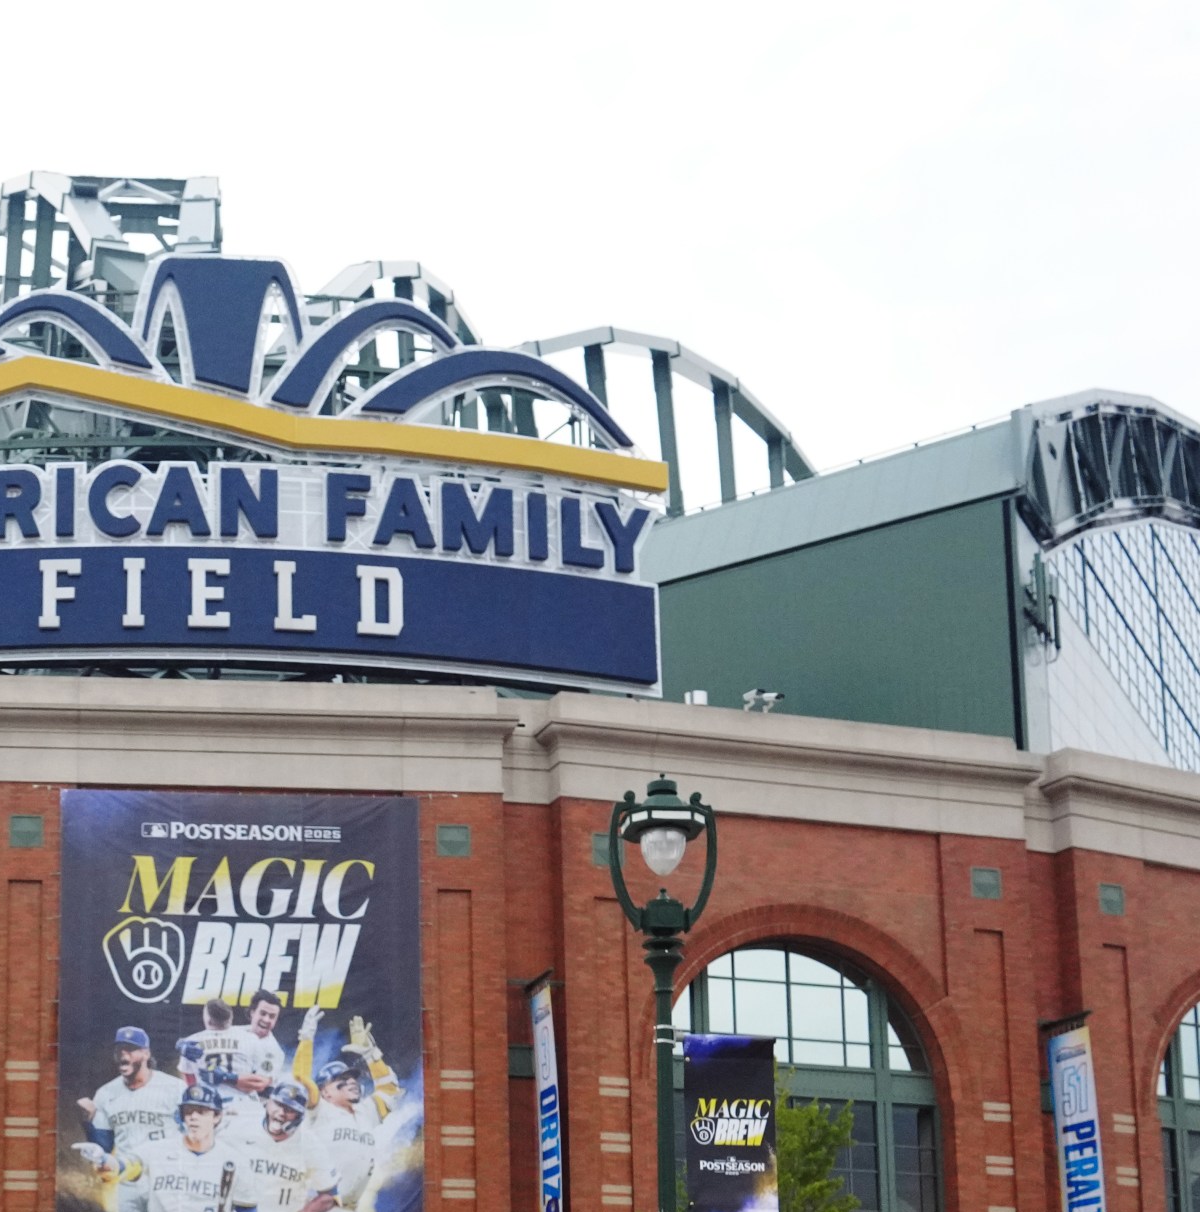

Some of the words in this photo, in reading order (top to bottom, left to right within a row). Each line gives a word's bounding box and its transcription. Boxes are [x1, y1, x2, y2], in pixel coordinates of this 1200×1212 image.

[324, 472, 648, 573] FAMILY
[38, 557, 403, 636] FIELD
[170, 822, 302, 842] POSTSEASON
[304, 828, 341, 840] 2025
[118, 855, 375, 919] MAGIC
[182, 922, 361, 1009] BREW
[1061, 1062, 1088, 1118] 51
[109, 1110, 165, 1128] REWERS
[695, 1098, 771, 1118] MAGIC
[540, 1084, 561, 1201] ORTIZ
[714, 1118, 767, 1146] BREW
[250, 1159, 304, 1182] EWERS
[700, 1160, 765, 1172] POSTSEASON
[279, 1188, 292, 1206] 11
